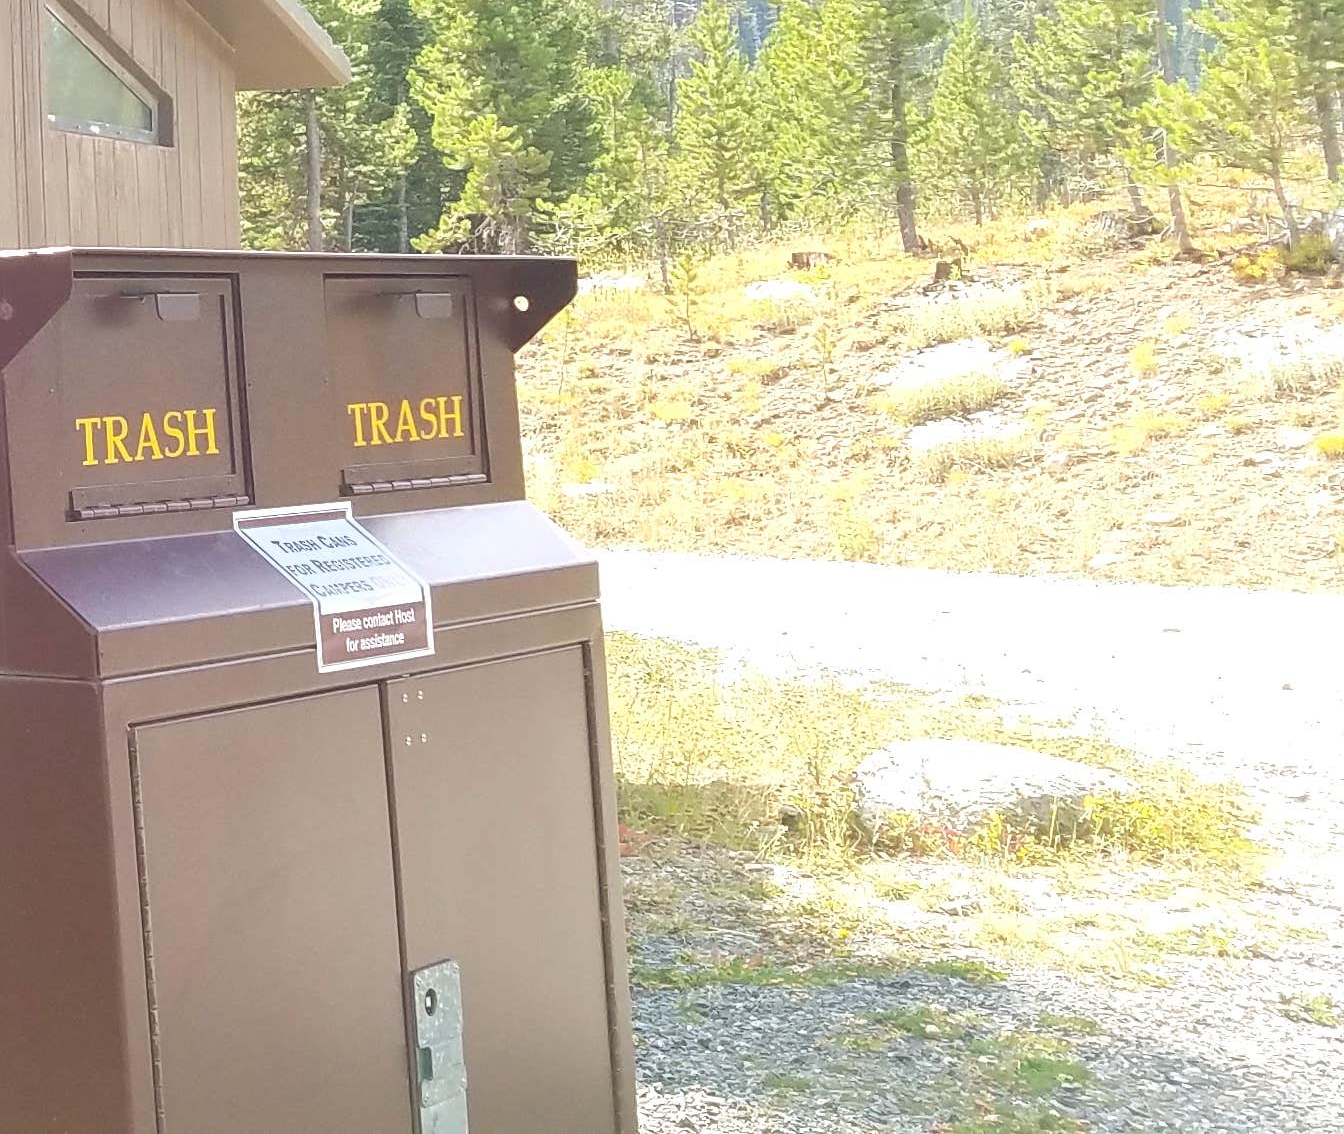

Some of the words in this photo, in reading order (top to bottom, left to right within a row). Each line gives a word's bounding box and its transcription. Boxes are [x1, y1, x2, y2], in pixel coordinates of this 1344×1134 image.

[347, 395, 465, 447] TRASH
[75, 408, 219, 467] TRASH
[286, 564, 317, 577] FOR
[310, 554, 392, 574] REGISTERED
[310, 580, 375, 598] CAMPERS
[332, 617, 362, 634] Please
[363, 613, 394, 629] contact
[394, 608, 416, 624] Host
[345, 637, 358, 653] for
[359, 632, 405, 651] assistance
